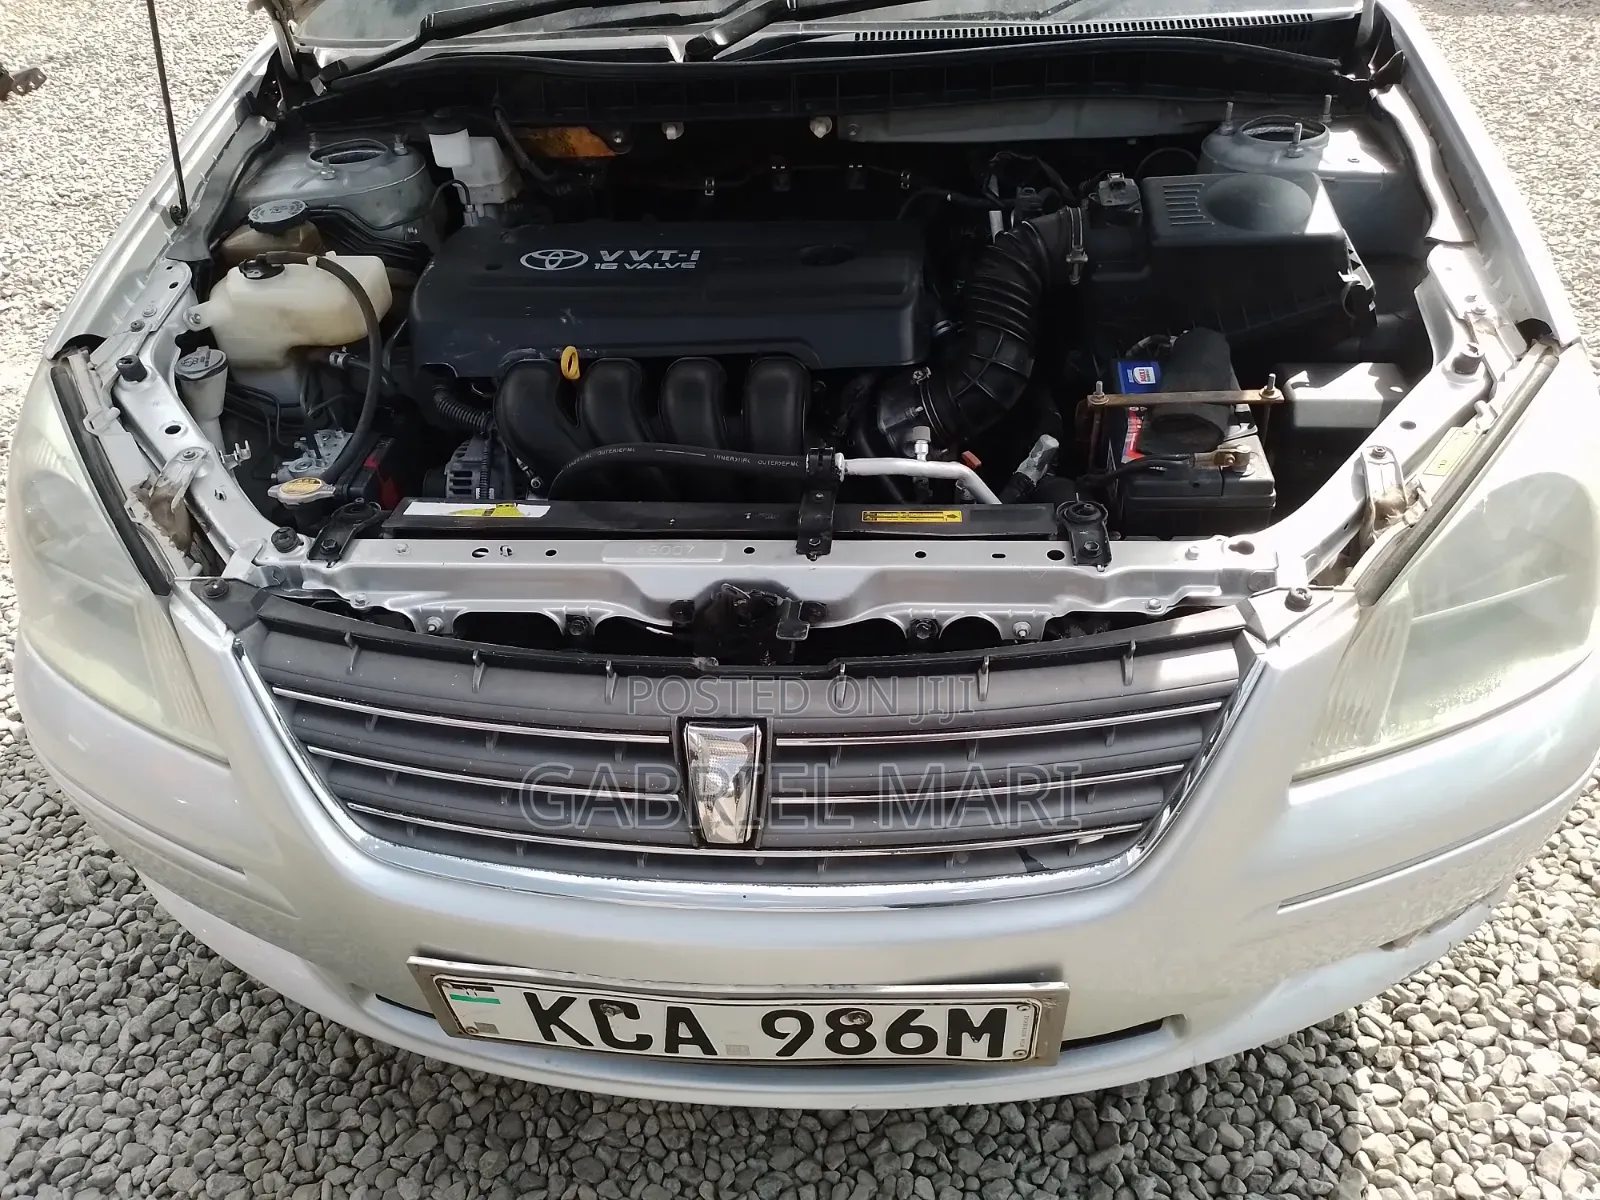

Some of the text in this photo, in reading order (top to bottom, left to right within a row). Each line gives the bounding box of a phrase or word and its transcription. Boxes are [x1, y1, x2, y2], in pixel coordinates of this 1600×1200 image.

[599, 249, 701, 262] VVT-i
[594, 261, 697, 270] 16 VALVE
[523, 991, 719, 1056] KCA
[760, 1007, 1008, 1058] 986M
